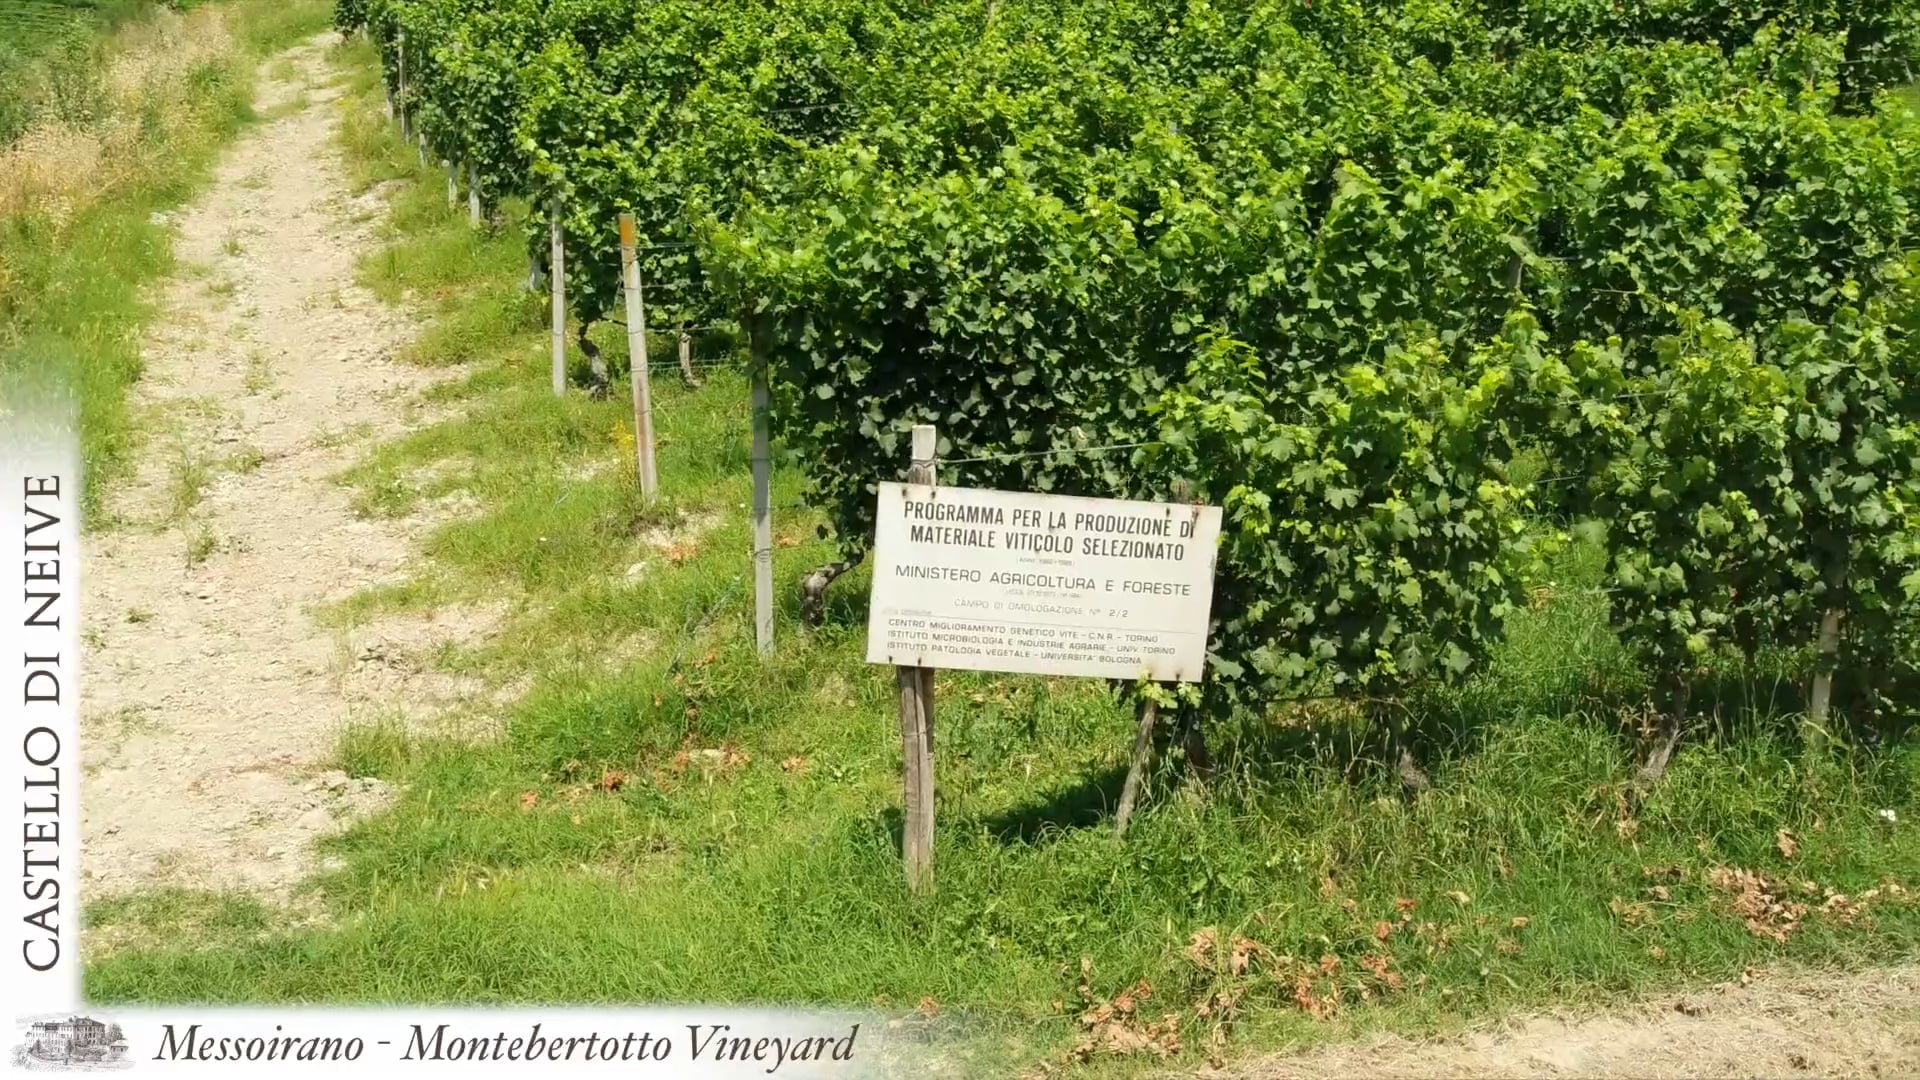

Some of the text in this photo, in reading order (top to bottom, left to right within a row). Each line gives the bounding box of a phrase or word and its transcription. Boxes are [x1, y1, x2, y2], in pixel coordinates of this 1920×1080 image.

[904, 501, 1194, 538] PROGRAMMA PER LA PRODUZIONE DI
[910, 525, 1184, 561] MATERIALE VITICOLO SELEZIONATO
[895, 565, 1192, 596] MINISTERO AGRICOLTURA E FORESTE
[954, 598, 989, 609] CAMPO
[994, 601, 1003, 610] DI
[1008, 602, 1083, 615] OMOLOGAZIONE
[1109, 609, 1128, 618] 2/2
[887, 630, 928, 640] ISTITUTO
[932, 634, 1003, 645] MICROBIOLOGIA
[1017, 640, 1065, 649] INDUSTRIE
[1069, 642, 1106, 651] AGRARIE
[1143, 646, 1176, 655] TORINO
[888, 618, 925, 629] CENTRO
[929, 622, 1006, 634] MIGLIORAMENTO
[1010, 627, 1055, 637] GENETICO
[1059, 631, 1078, 639] VITE
[1125, 635, 1159, 643] TORINO
[887, 642, 928, 651] ISTITUTO
[931, 645, 982, 655] PATOLOGIA
[985, 649, 1030, 658] VEGETALE
[1099, 655, 1142, 664] BOLOGNA
